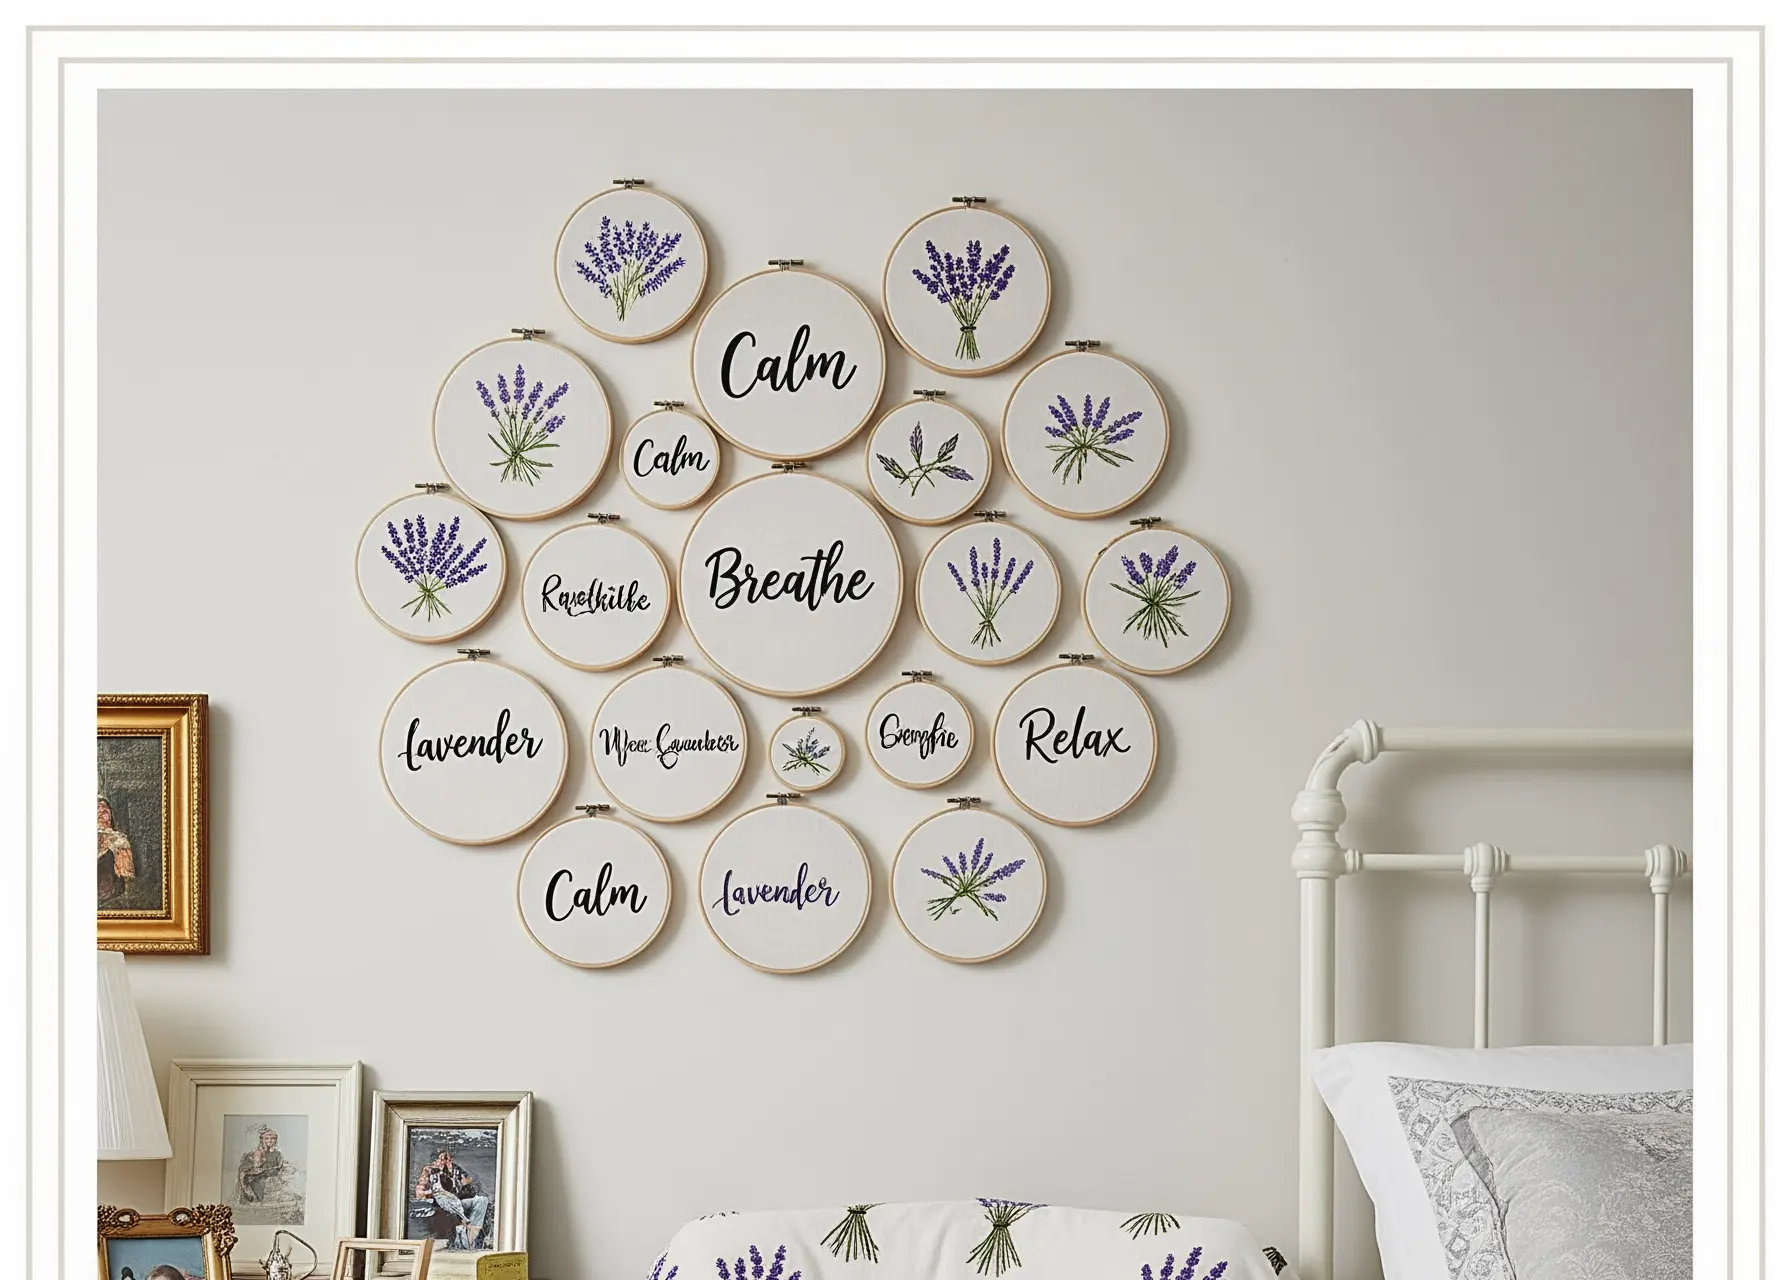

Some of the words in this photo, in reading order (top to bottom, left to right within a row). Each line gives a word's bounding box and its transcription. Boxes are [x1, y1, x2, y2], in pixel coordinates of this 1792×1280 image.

[721, 325, 857, 398] Calm
[634, 435, 710, 478] Calm
[705, 540, 874, 611] Breathe
[398, 709, 543, 771] Lavender
[1019, 706, 1131, 763] Relax
[546, 862, 647, 921] Calm
[712, 862, 840, 916] Lavender
